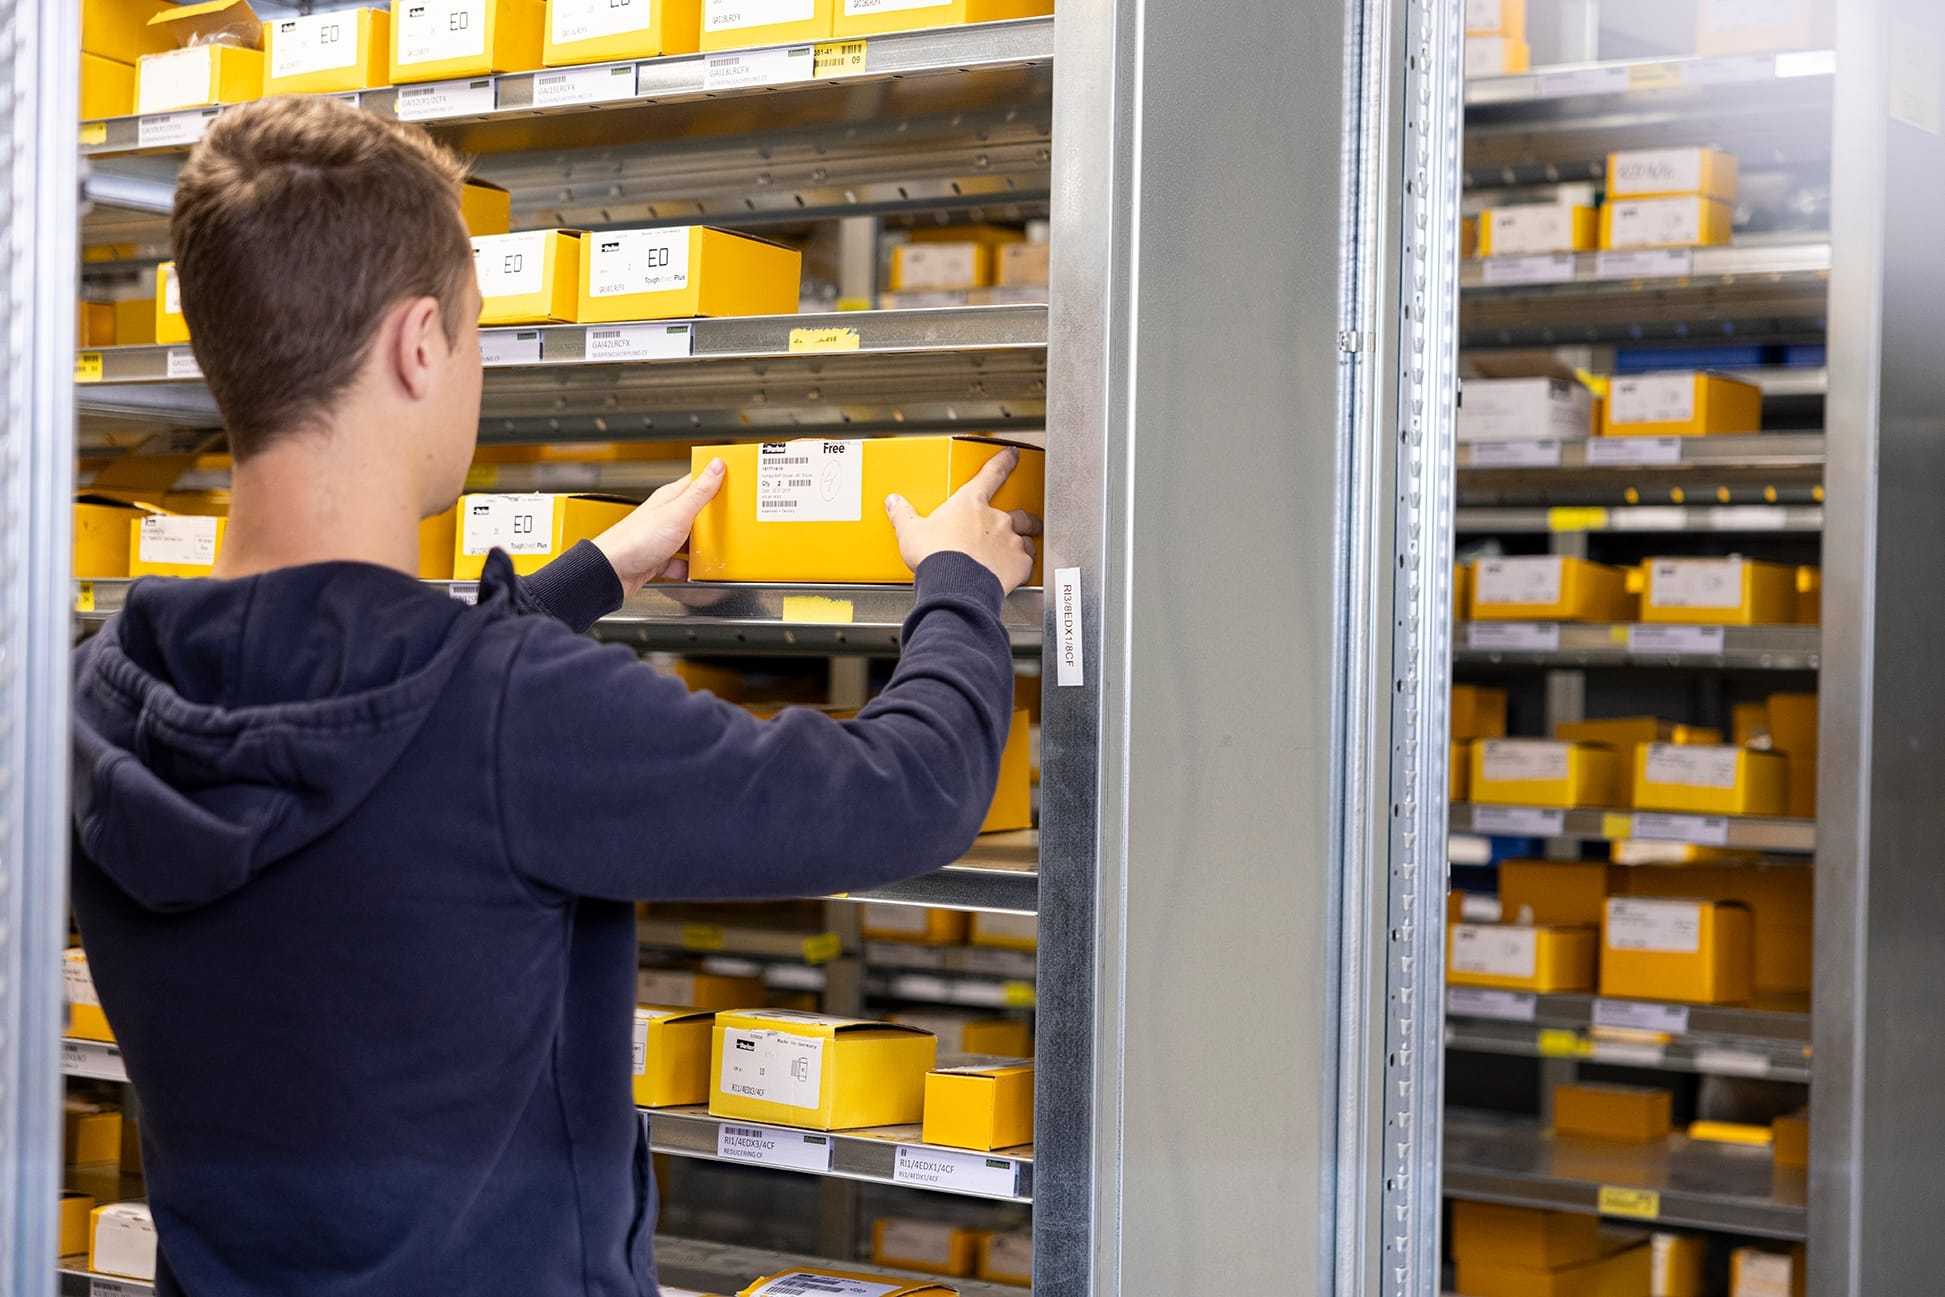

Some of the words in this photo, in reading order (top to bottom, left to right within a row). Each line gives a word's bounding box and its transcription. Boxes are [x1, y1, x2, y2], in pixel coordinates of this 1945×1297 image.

[851, 55, 861, 65] 09
[823, 442, 845, 454] Free
[1063, 584, 1075, 668] RI3/8EDX1/8CF
[724, 1136, 776, 1150] RI1/4EDX3/4CF
[899, 1158, 955, 1174] RI1/4EDX1/4CF
